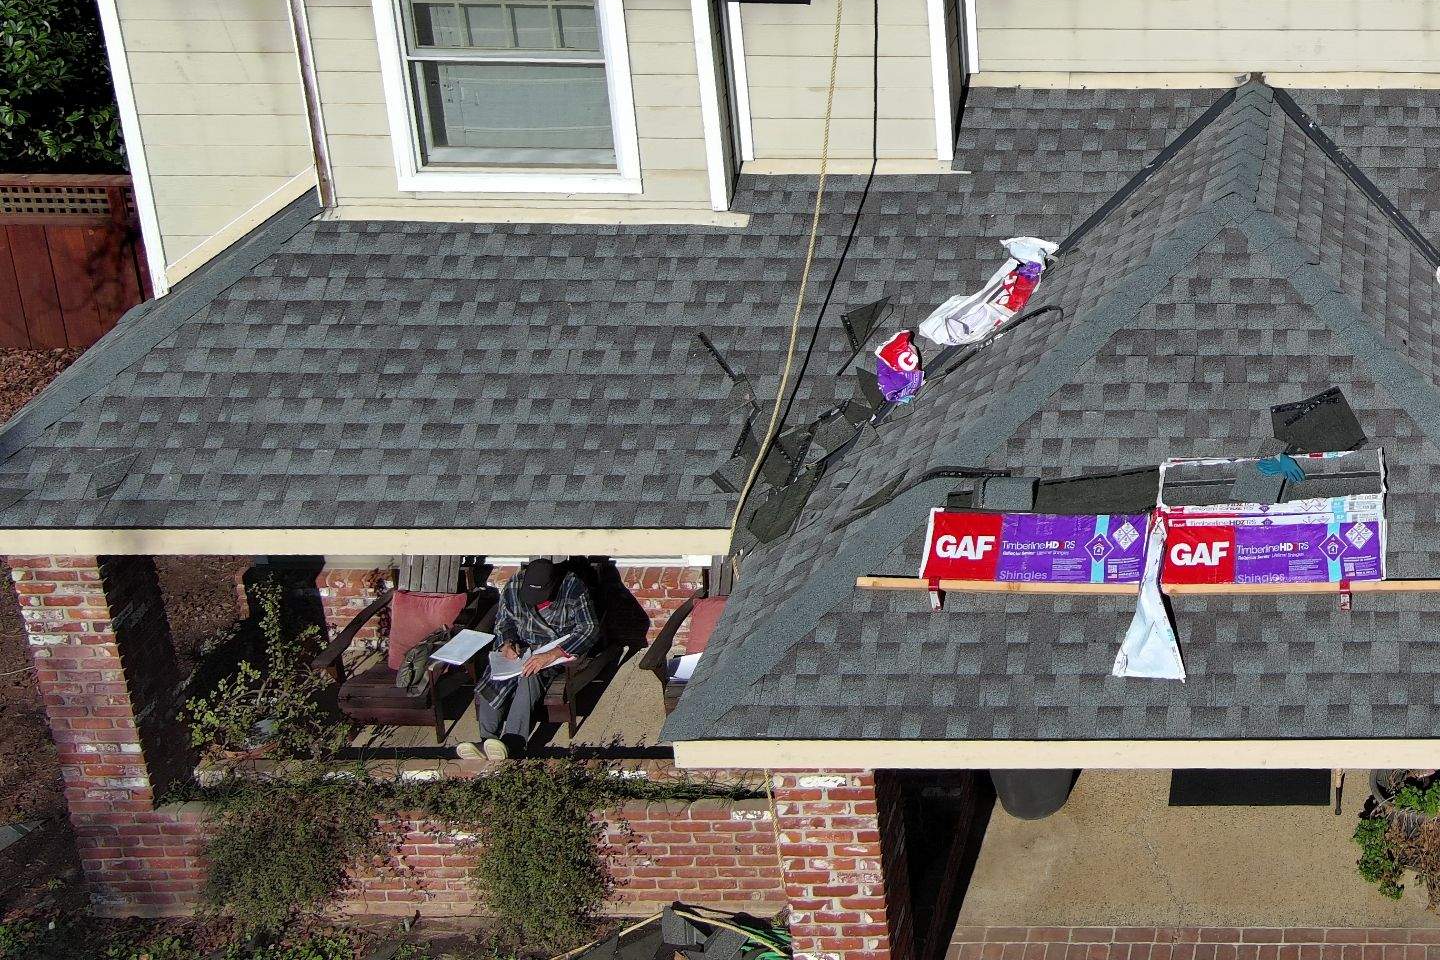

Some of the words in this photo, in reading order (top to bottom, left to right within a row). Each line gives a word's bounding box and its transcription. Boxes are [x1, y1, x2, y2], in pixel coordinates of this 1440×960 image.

[935, 535, 996, 560] GAF
[1170, 541, 1230, 566] GAF
[999, 570, 1048, 581] Shingles
